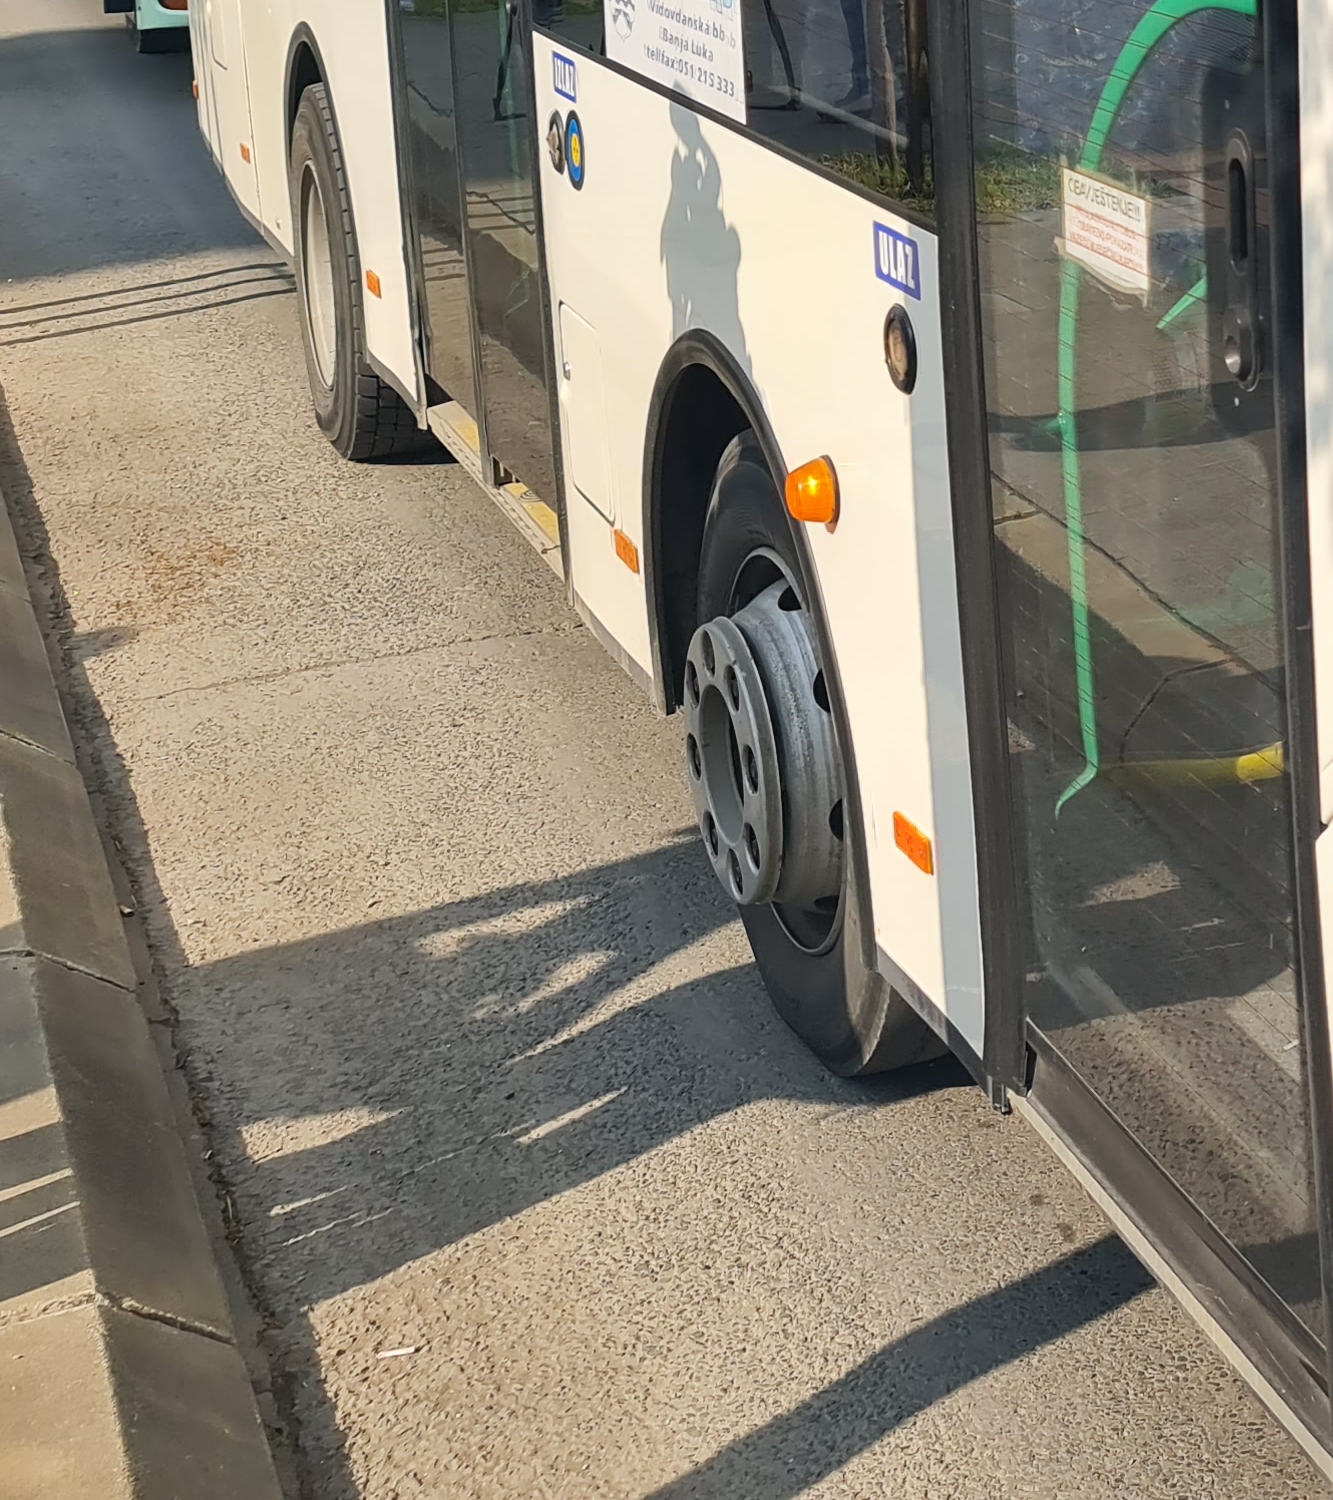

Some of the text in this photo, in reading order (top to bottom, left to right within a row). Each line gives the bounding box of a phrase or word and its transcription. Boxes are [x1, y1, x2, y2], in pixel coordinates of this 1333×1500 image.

[661, 27, 714, 62] Banja Luka
[554, 56, 575, 97] IZLAZ
[697, 66, 715, 88] 215
[716, 75, 735, 98] 333
[878, 230, 916, 290] ULAZ
